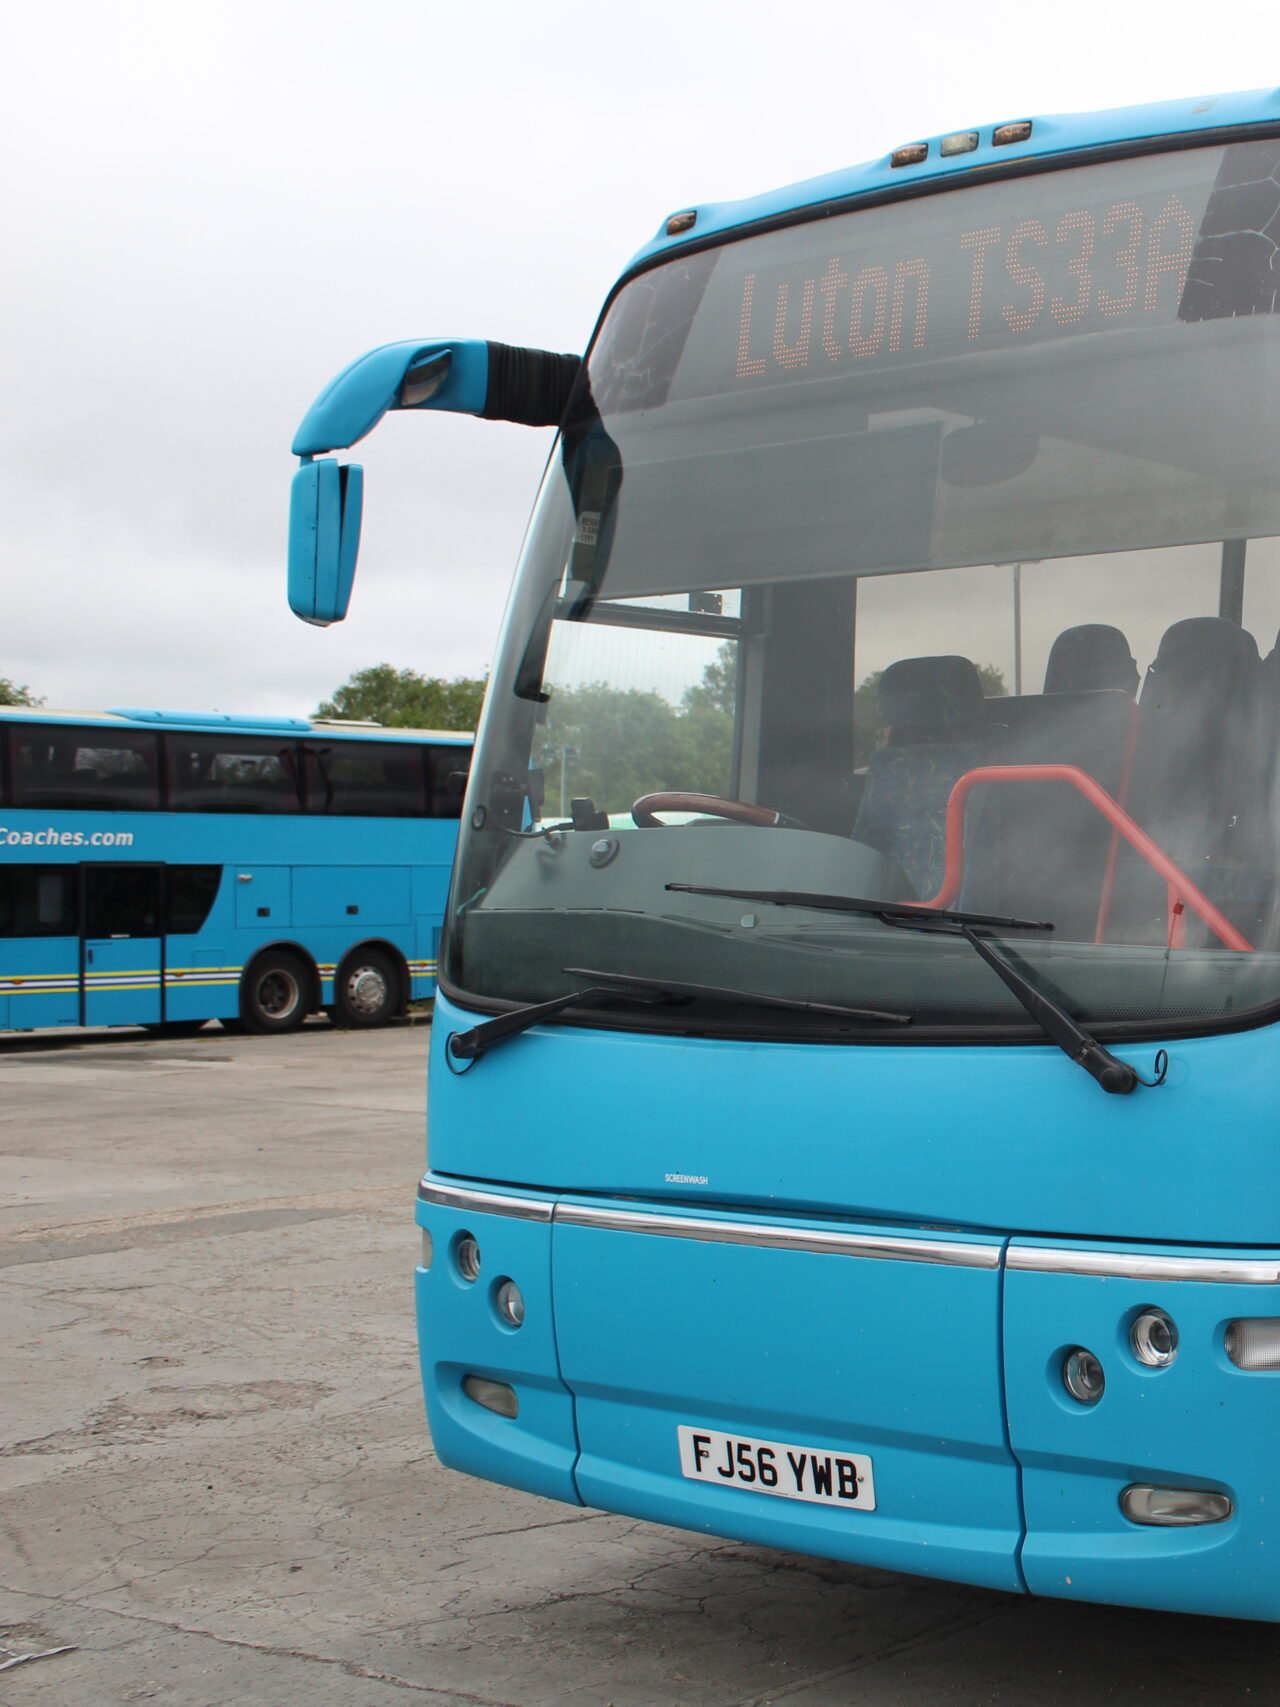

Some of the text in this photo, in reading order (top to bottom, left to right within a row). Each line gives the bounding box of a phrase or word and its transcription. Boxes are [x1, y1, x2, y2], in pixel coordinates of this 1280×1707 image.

[736, 194, 1194, 377] Luton TS33A
[664, 1173, 709, 1185] SCREENWASH
[693, 1434, 859, 1500] FJ56 YWB
